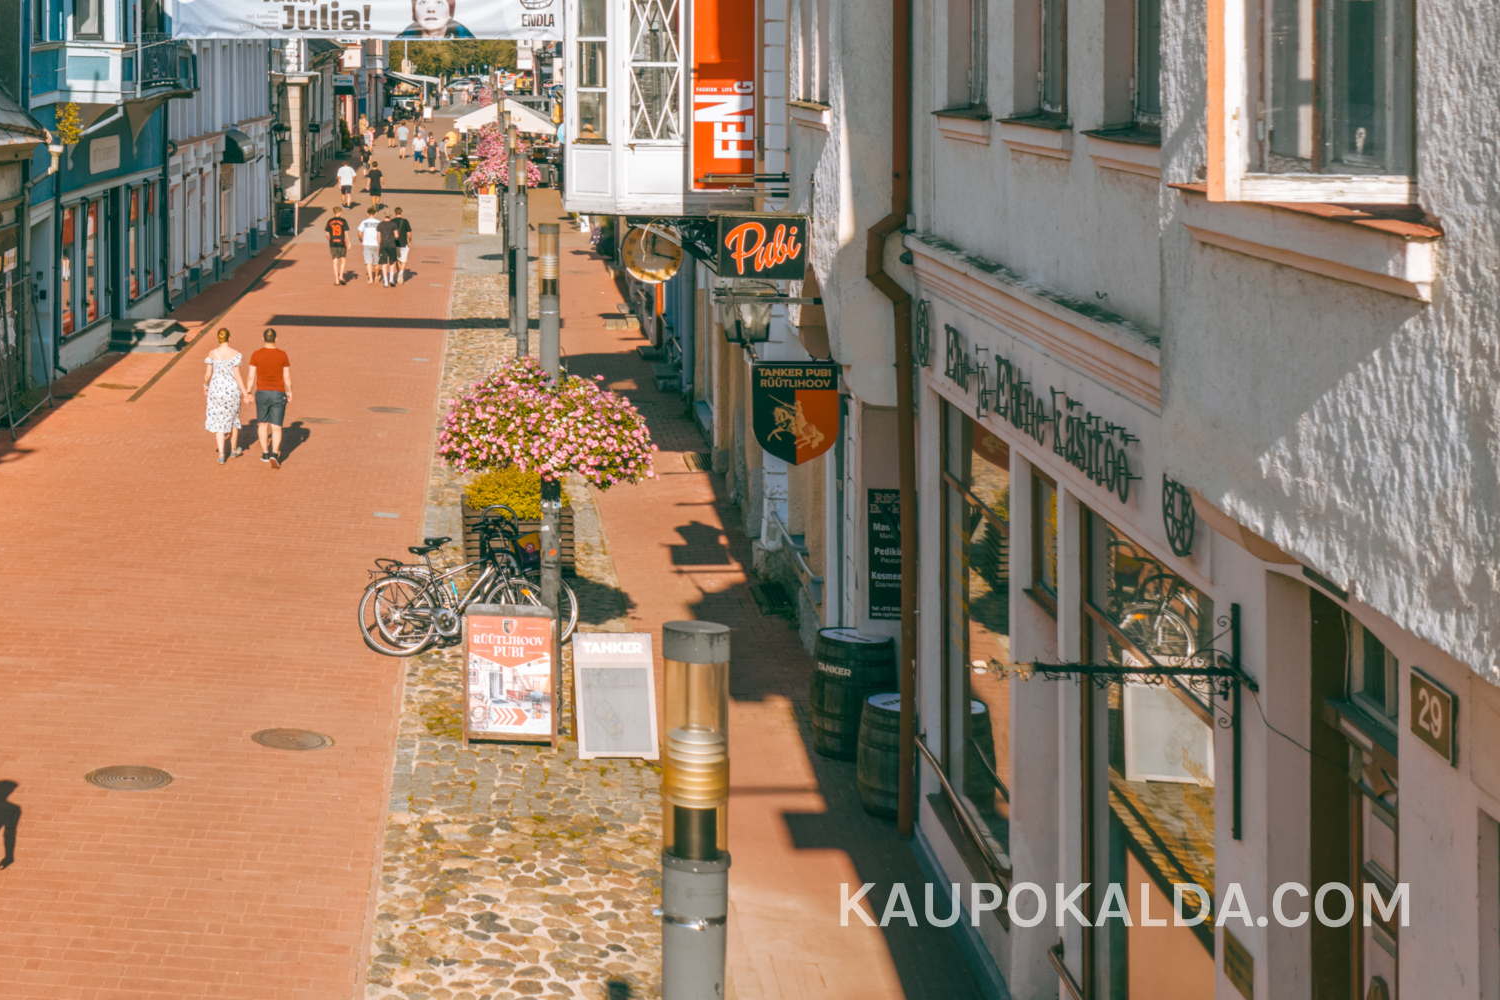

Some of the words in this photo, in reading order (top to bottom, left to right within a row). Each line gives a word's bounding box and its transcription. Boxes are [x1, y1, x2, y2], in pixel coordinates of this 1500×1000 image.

[282, 1, 371, 31] Julia!
[521, 13, 555, 27] ENDLA
[331, 224, 342, 236] 19
[724, 221, 802, 275] Pubi
[758, 368, 803, 377] TANKER
[805, 368, 832, 377] PUBI
[760, 377, 831, 388] RÜÜTLIHOOV
[473, 633, 544, 646] RÜÜTLIHOOV
[493, 646, 524, 658] PUBI
[582, 641, 642, 654] TANKER
[818, 662, 852, 677] TANKER
[1419, 687, 1443, 739] 29
